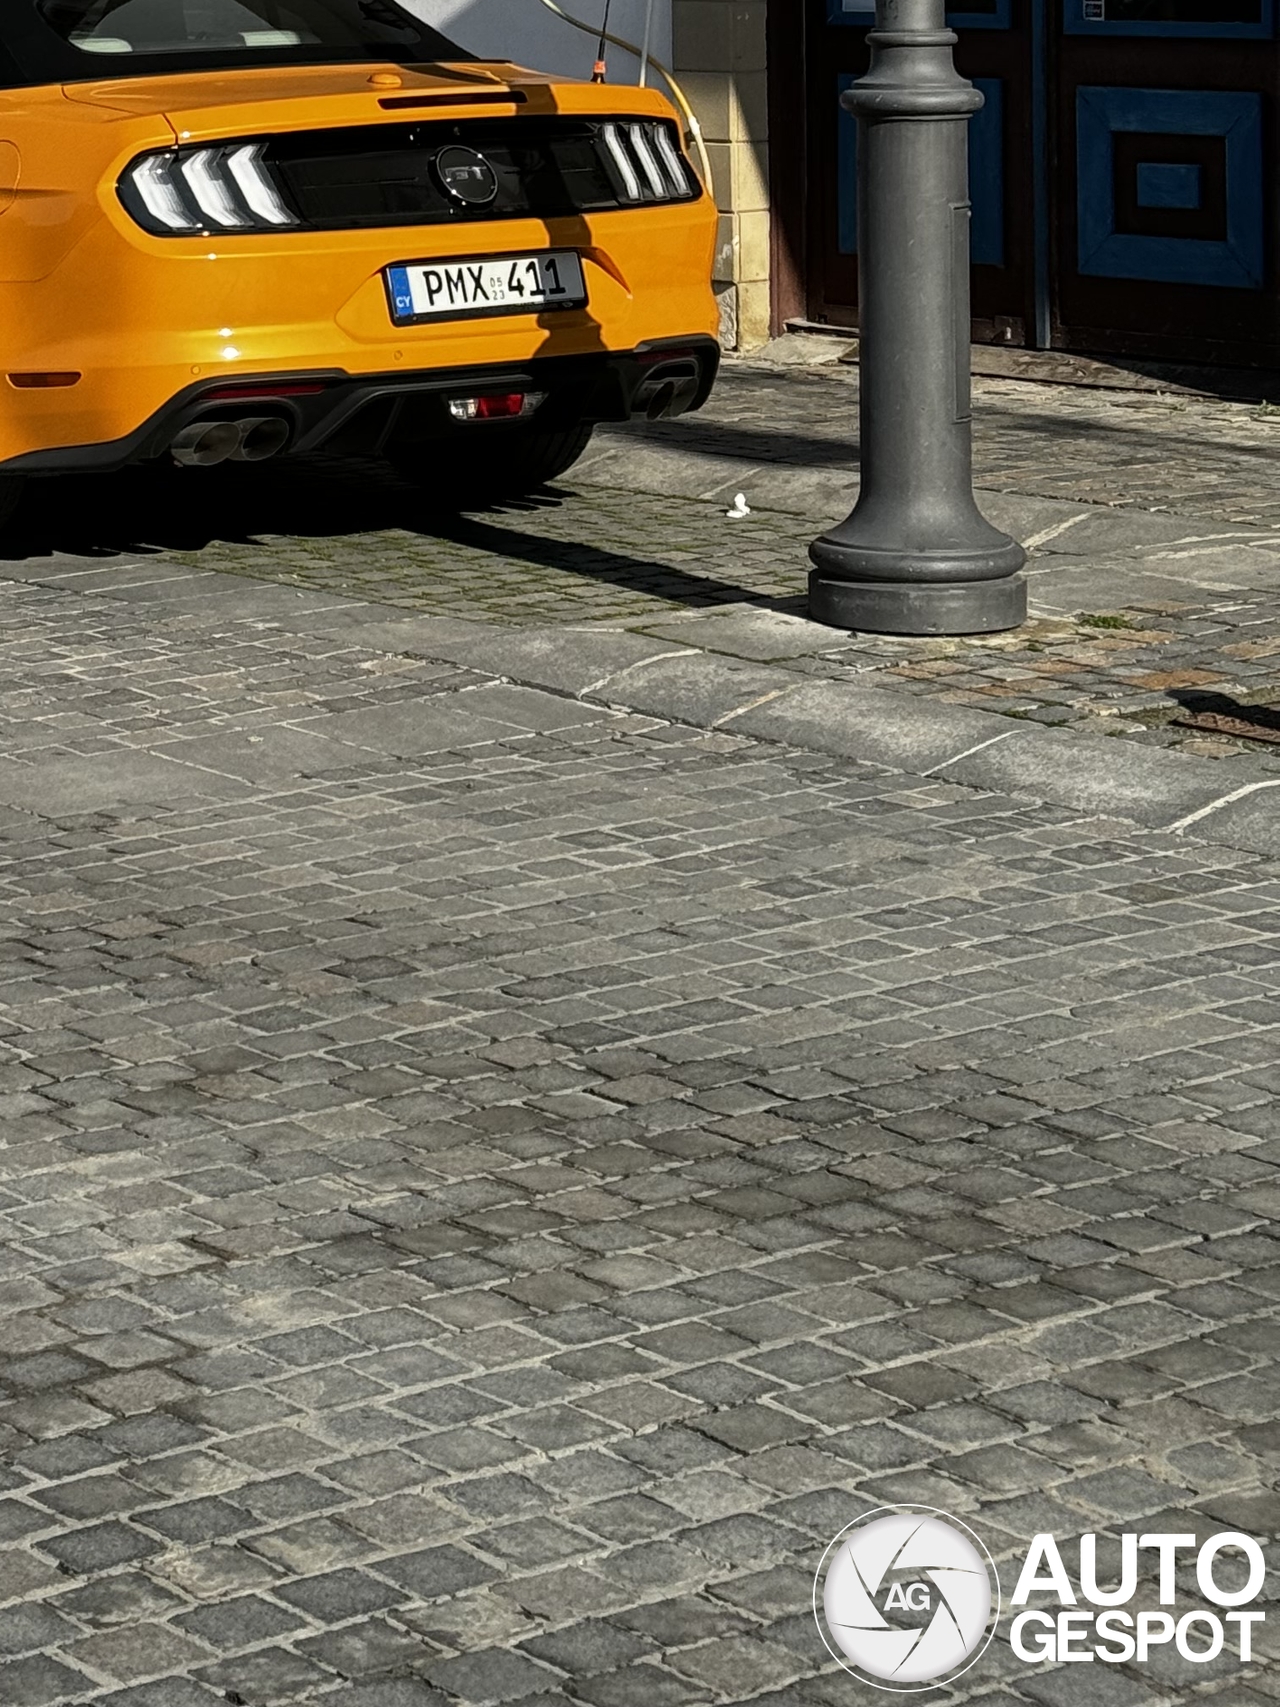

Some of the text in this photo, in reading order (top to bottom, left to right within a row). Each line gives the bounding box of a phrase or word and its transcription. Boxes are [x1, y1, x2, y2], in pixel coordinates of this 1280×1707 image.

[423, 258, 566, 306] PMX 411
[396, 296, 411, 308] CY
